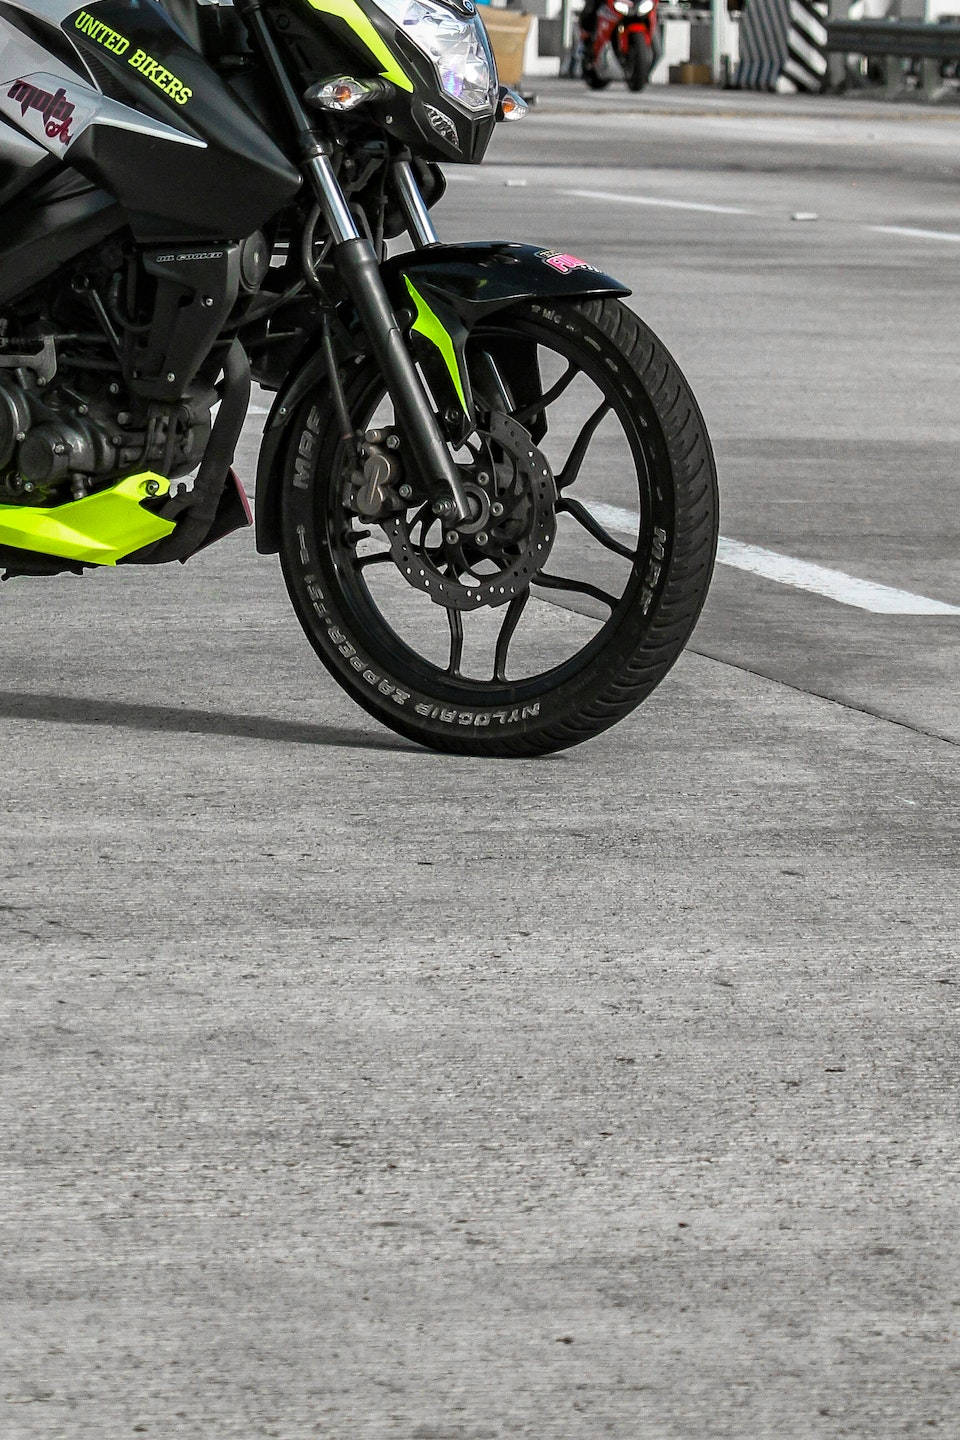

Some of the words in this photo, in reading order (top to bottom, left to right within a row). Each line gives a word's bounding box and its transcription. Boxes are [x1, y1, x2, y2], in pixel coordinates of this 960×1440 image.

[74, 11, 130, 55] UNITED
[127, 48, 193, 105] BIKERS
[293, 406, 323, 490] MRF
[414, 702, 541, 728] NYLOGRIP
